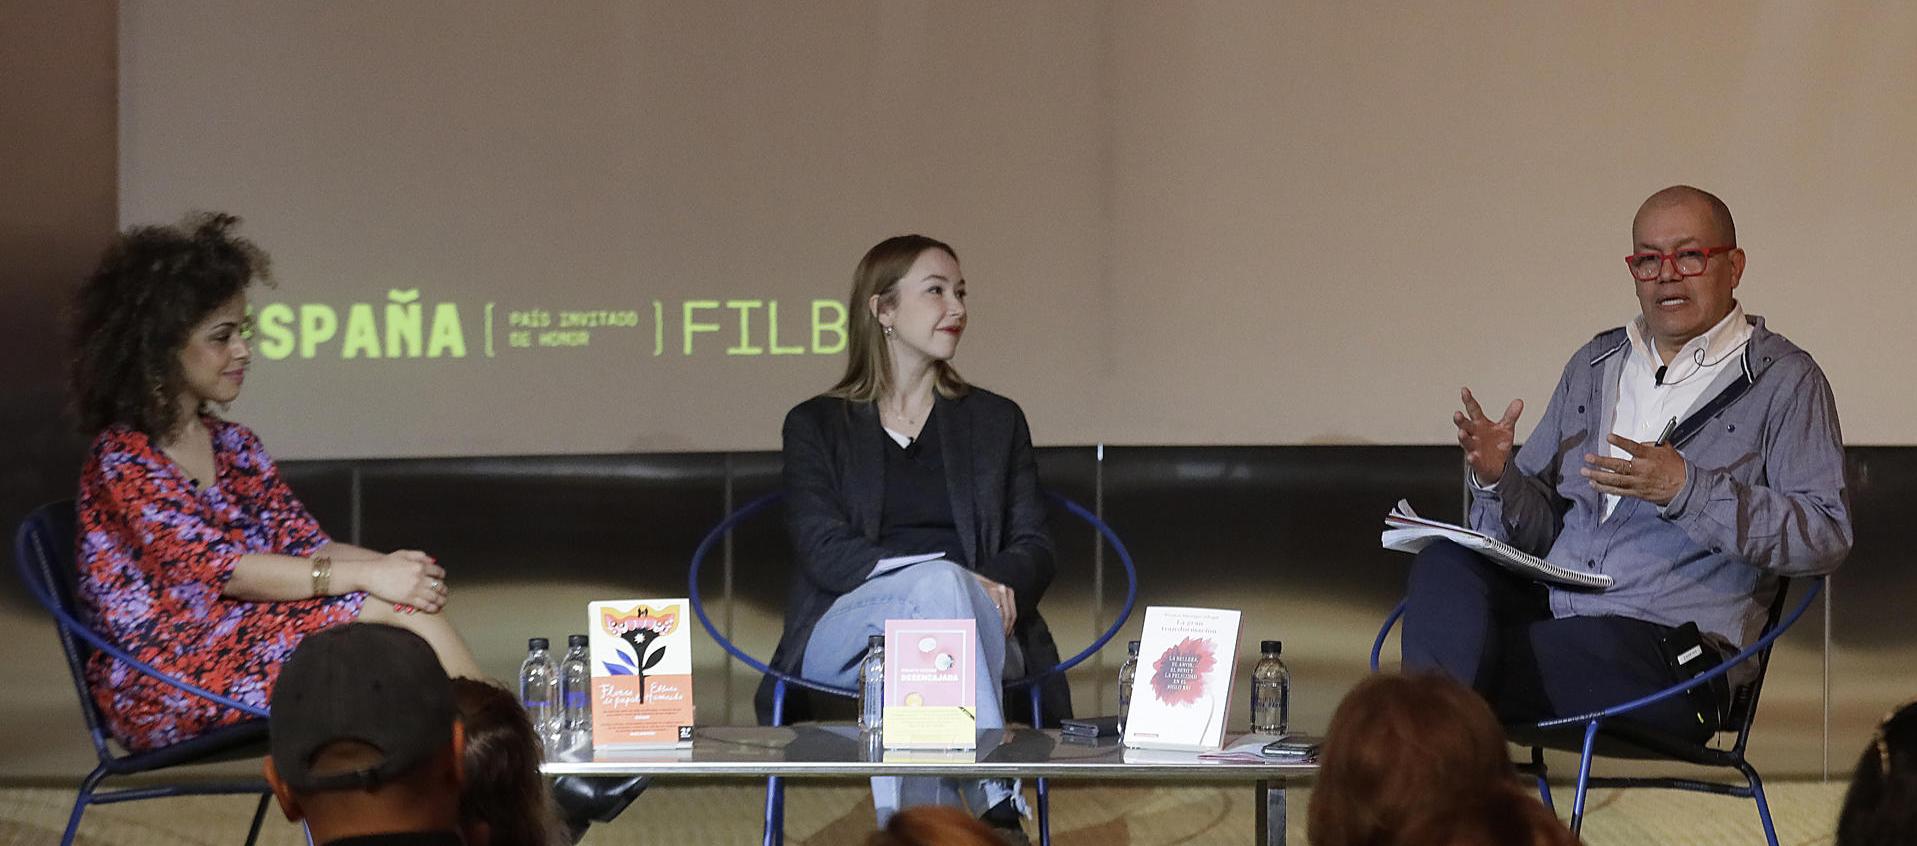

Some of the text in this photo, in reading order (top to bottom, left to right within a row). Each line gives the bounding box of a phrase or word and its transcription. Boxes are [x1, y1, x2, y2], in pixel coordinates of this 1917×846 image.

[509, 309, 639, 327] PAÍS INVITADO
[509, 330, 590, 347] DE HONOR
